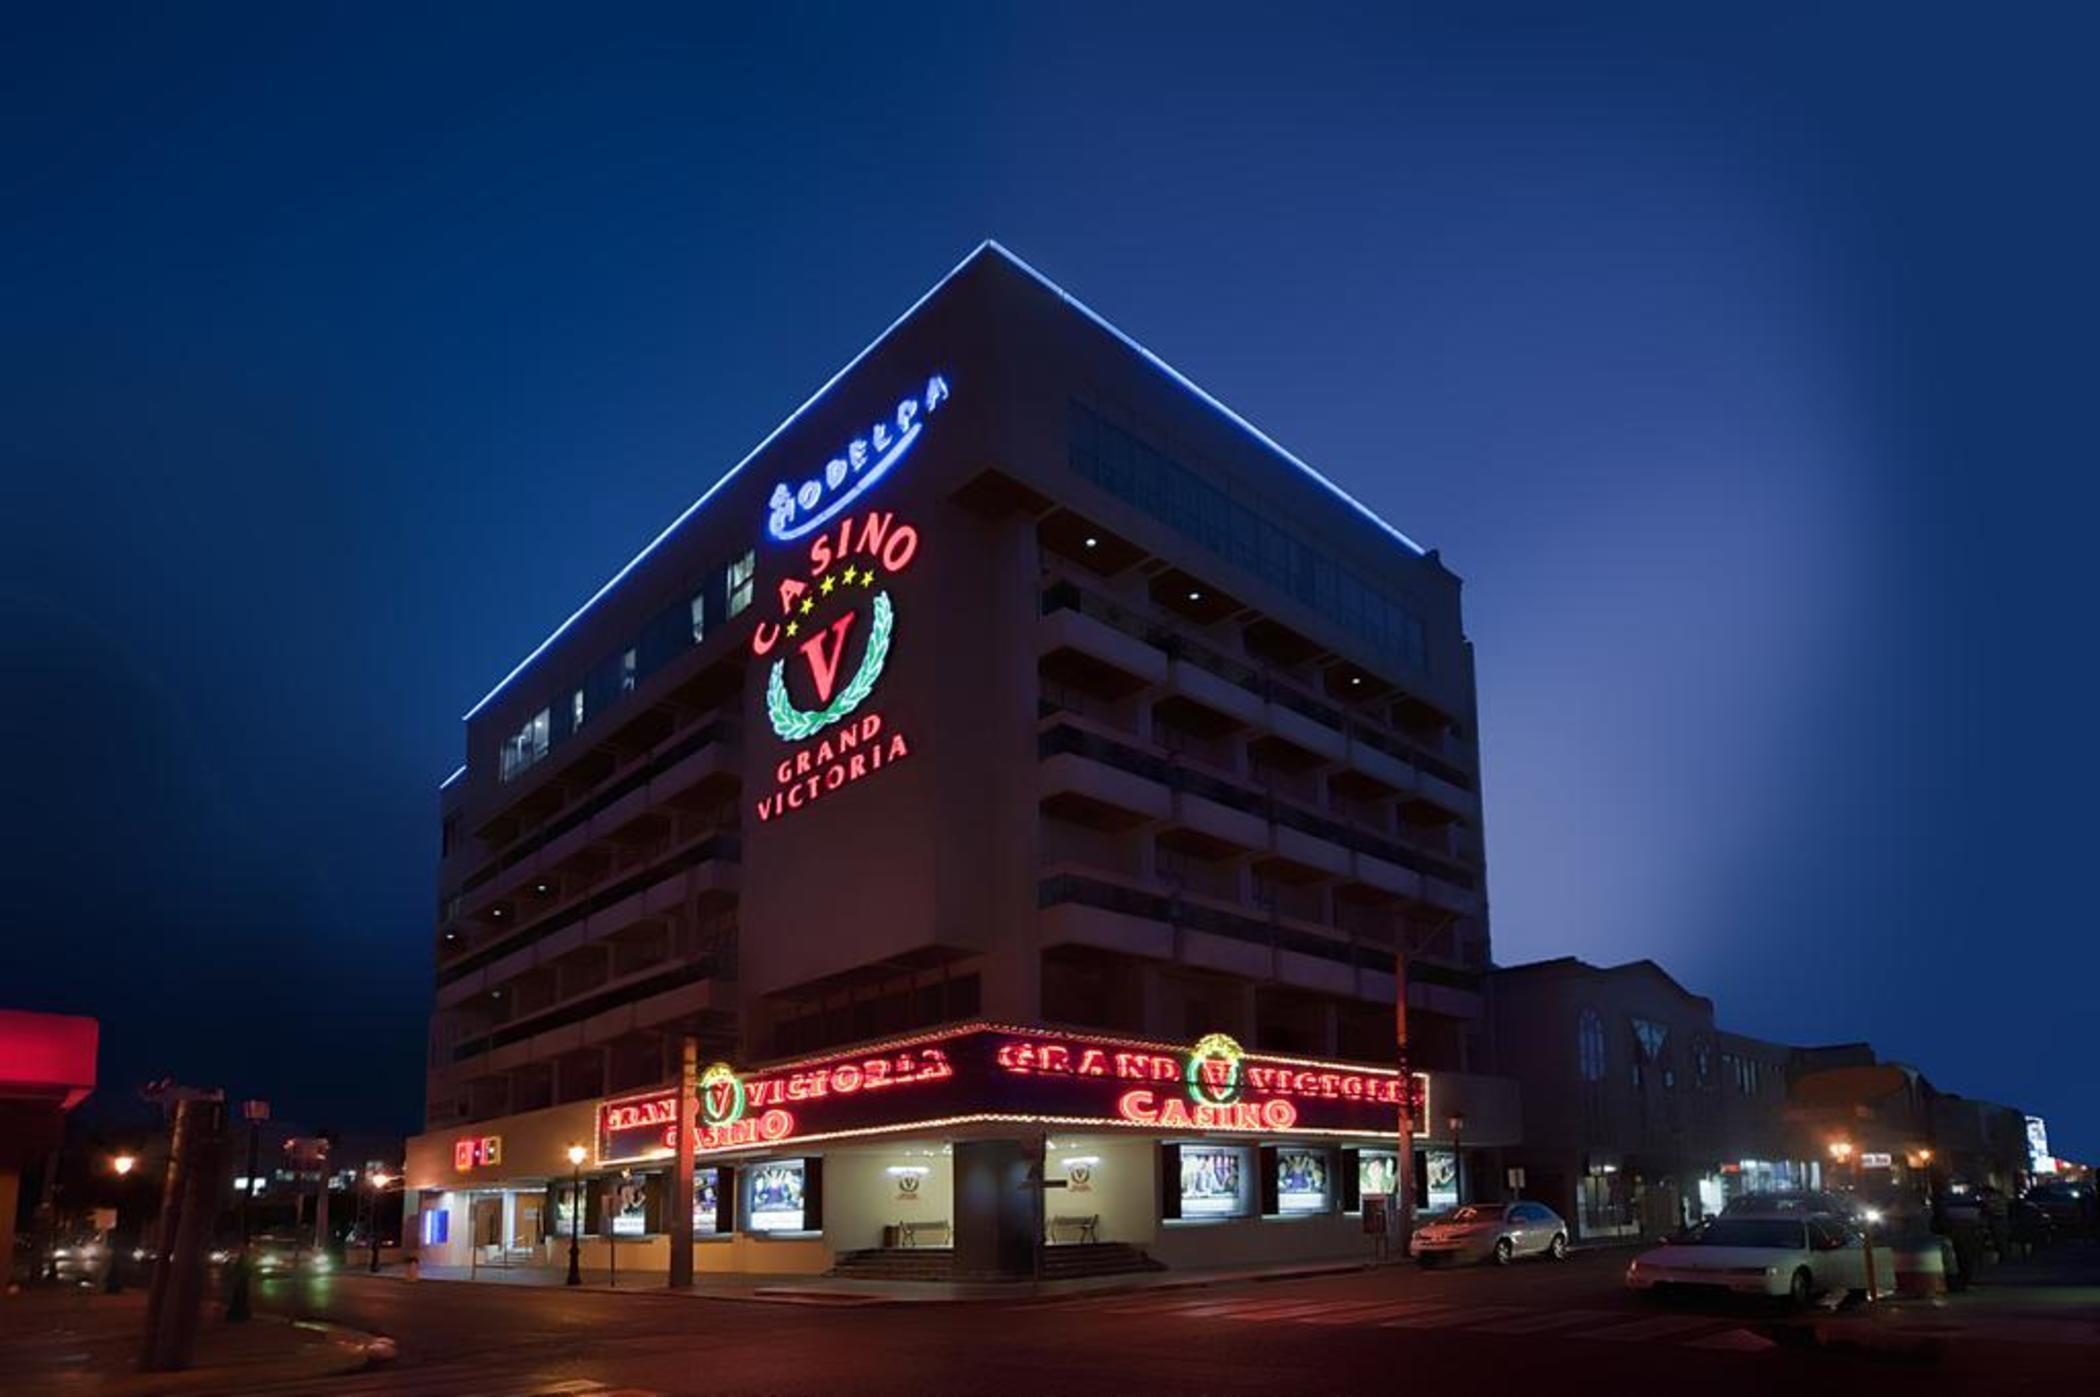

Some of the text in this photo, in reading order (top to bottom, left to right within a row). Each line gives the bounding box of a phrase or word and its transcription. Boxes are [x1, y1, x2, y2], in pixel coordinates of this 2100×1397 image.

[753, 512, 917, 655] CASINO
[799, 611, 856, 702] V
[758, 734, 907, 820] VICTORIA
[777, 714, 881, 783] GRAND
[998, 1043, 1182, 1082] GRAND
[1119, 1090, 1297, 1129] CASINO
